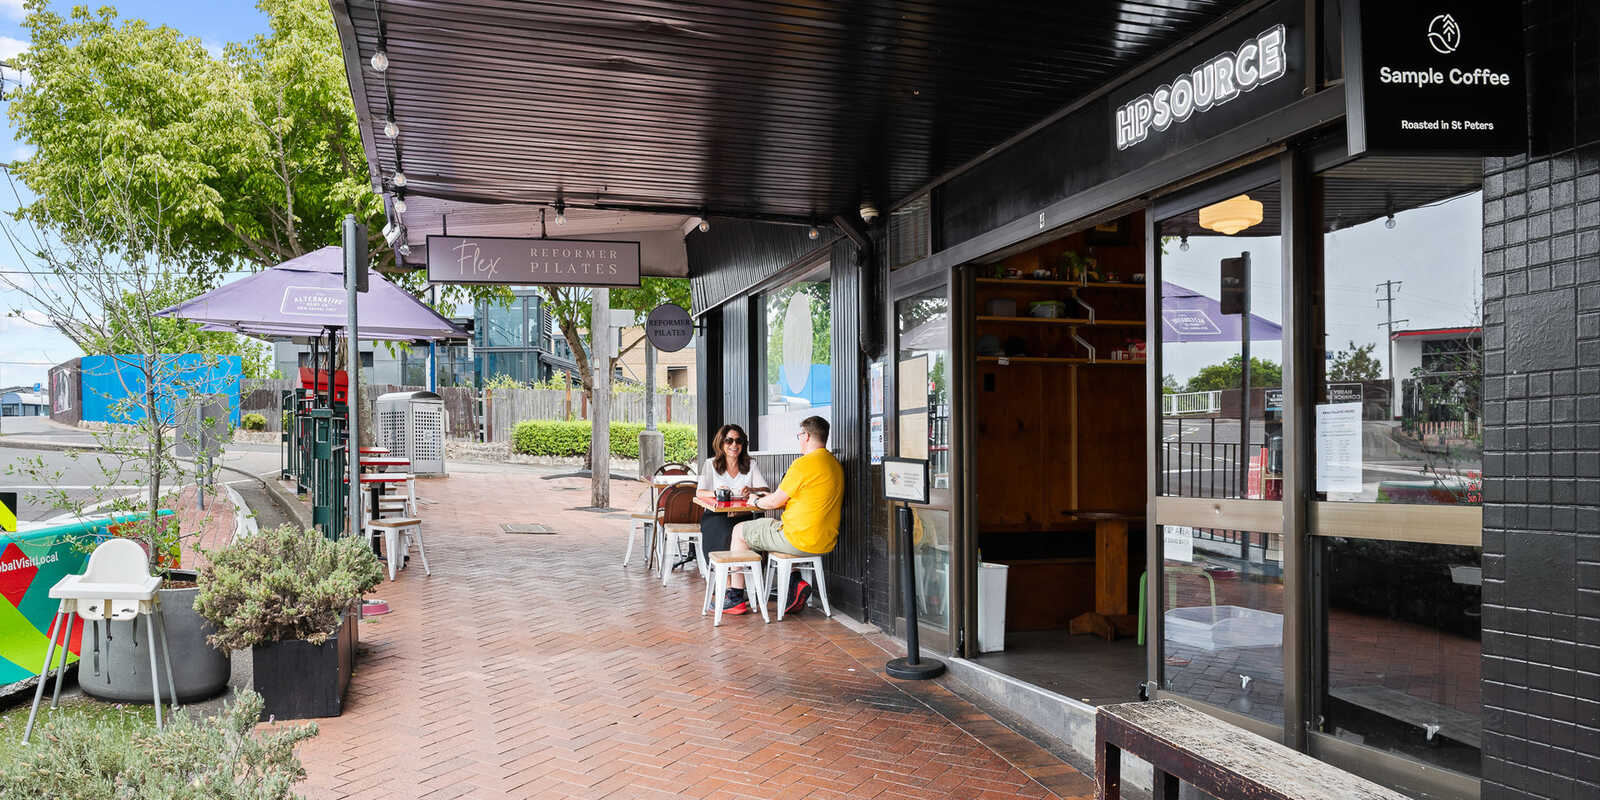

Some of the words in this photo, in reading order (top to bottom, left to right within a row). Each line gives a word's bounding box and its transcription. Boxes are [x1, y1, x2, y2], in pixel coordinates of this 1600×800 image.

[1380, 66, 1444, 88] Sample
[1449, 68, 1510, 85] Coffee
[1117, 26, 1285, 149] HPSOURCE
[1401, 120, 1439, 130] Roasted
[1440, 120, 1450, 130] in
[1451, 120, 1462, 130] St
[1464, 121, 1495, 130] Peters
[452, 239, 504, 279] Flex
[530, 248, 617, 260] REFORMER
[530, 262, 617, 275] PILATES
[649, 319, 691, 327] REFORMER
[654, 329, 686, 337] PILATES
